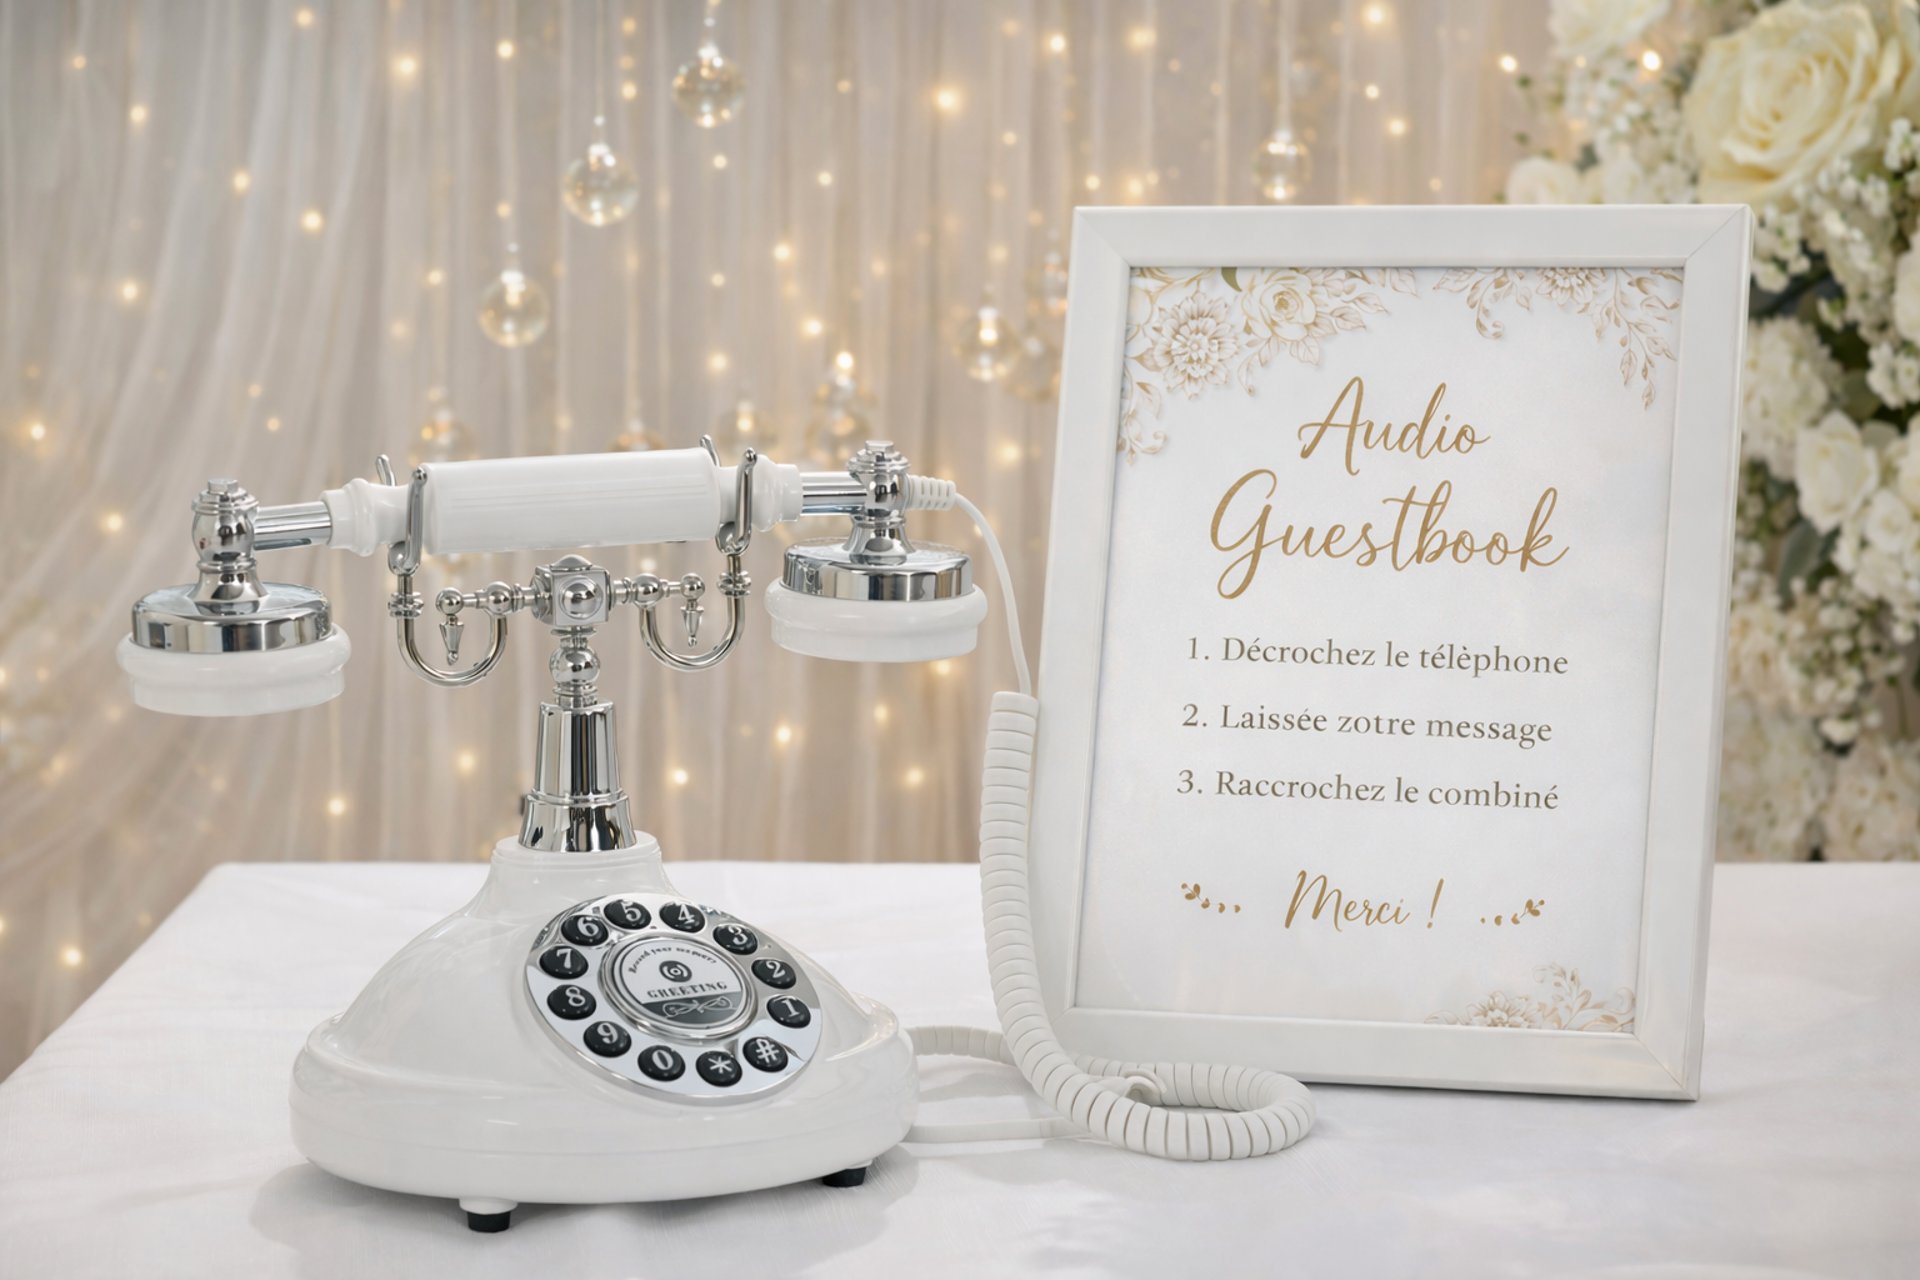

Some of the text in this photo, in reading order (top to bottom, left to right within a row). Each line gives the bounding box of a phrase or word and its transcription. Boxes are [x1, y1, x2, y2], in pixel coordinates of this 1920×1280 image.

[1297, 375, 1491, 477] Audio
[1209, 465, 1570, 600] Guestbook
[1189, 637, 1210, 661] 1.
[1222, 637, 1376, 666] Décrochez
[1385, 640, 1410, 668] le
[1182, 703, 1552, 750] 2. Laissée zotre message
[1176, 769, 1559, 810] 3. Raccrochez le combiné
[1284, 869, 1411, 932] Merci
[621, 901, 642, 924] 5
[678, 906, 696, 925] 4
[577, 918, 599, 938] 6
[728, 927, 749, 946] 3
[556, 949, 574, 968] 7
[766, 961, 786, 979] 2
[567, 988, 587, 1007] 8
[781, 1000, 799, 1016] 1
[598, 1023, 619, 1044] 9
[652, 1050, 674, 1071] 0
